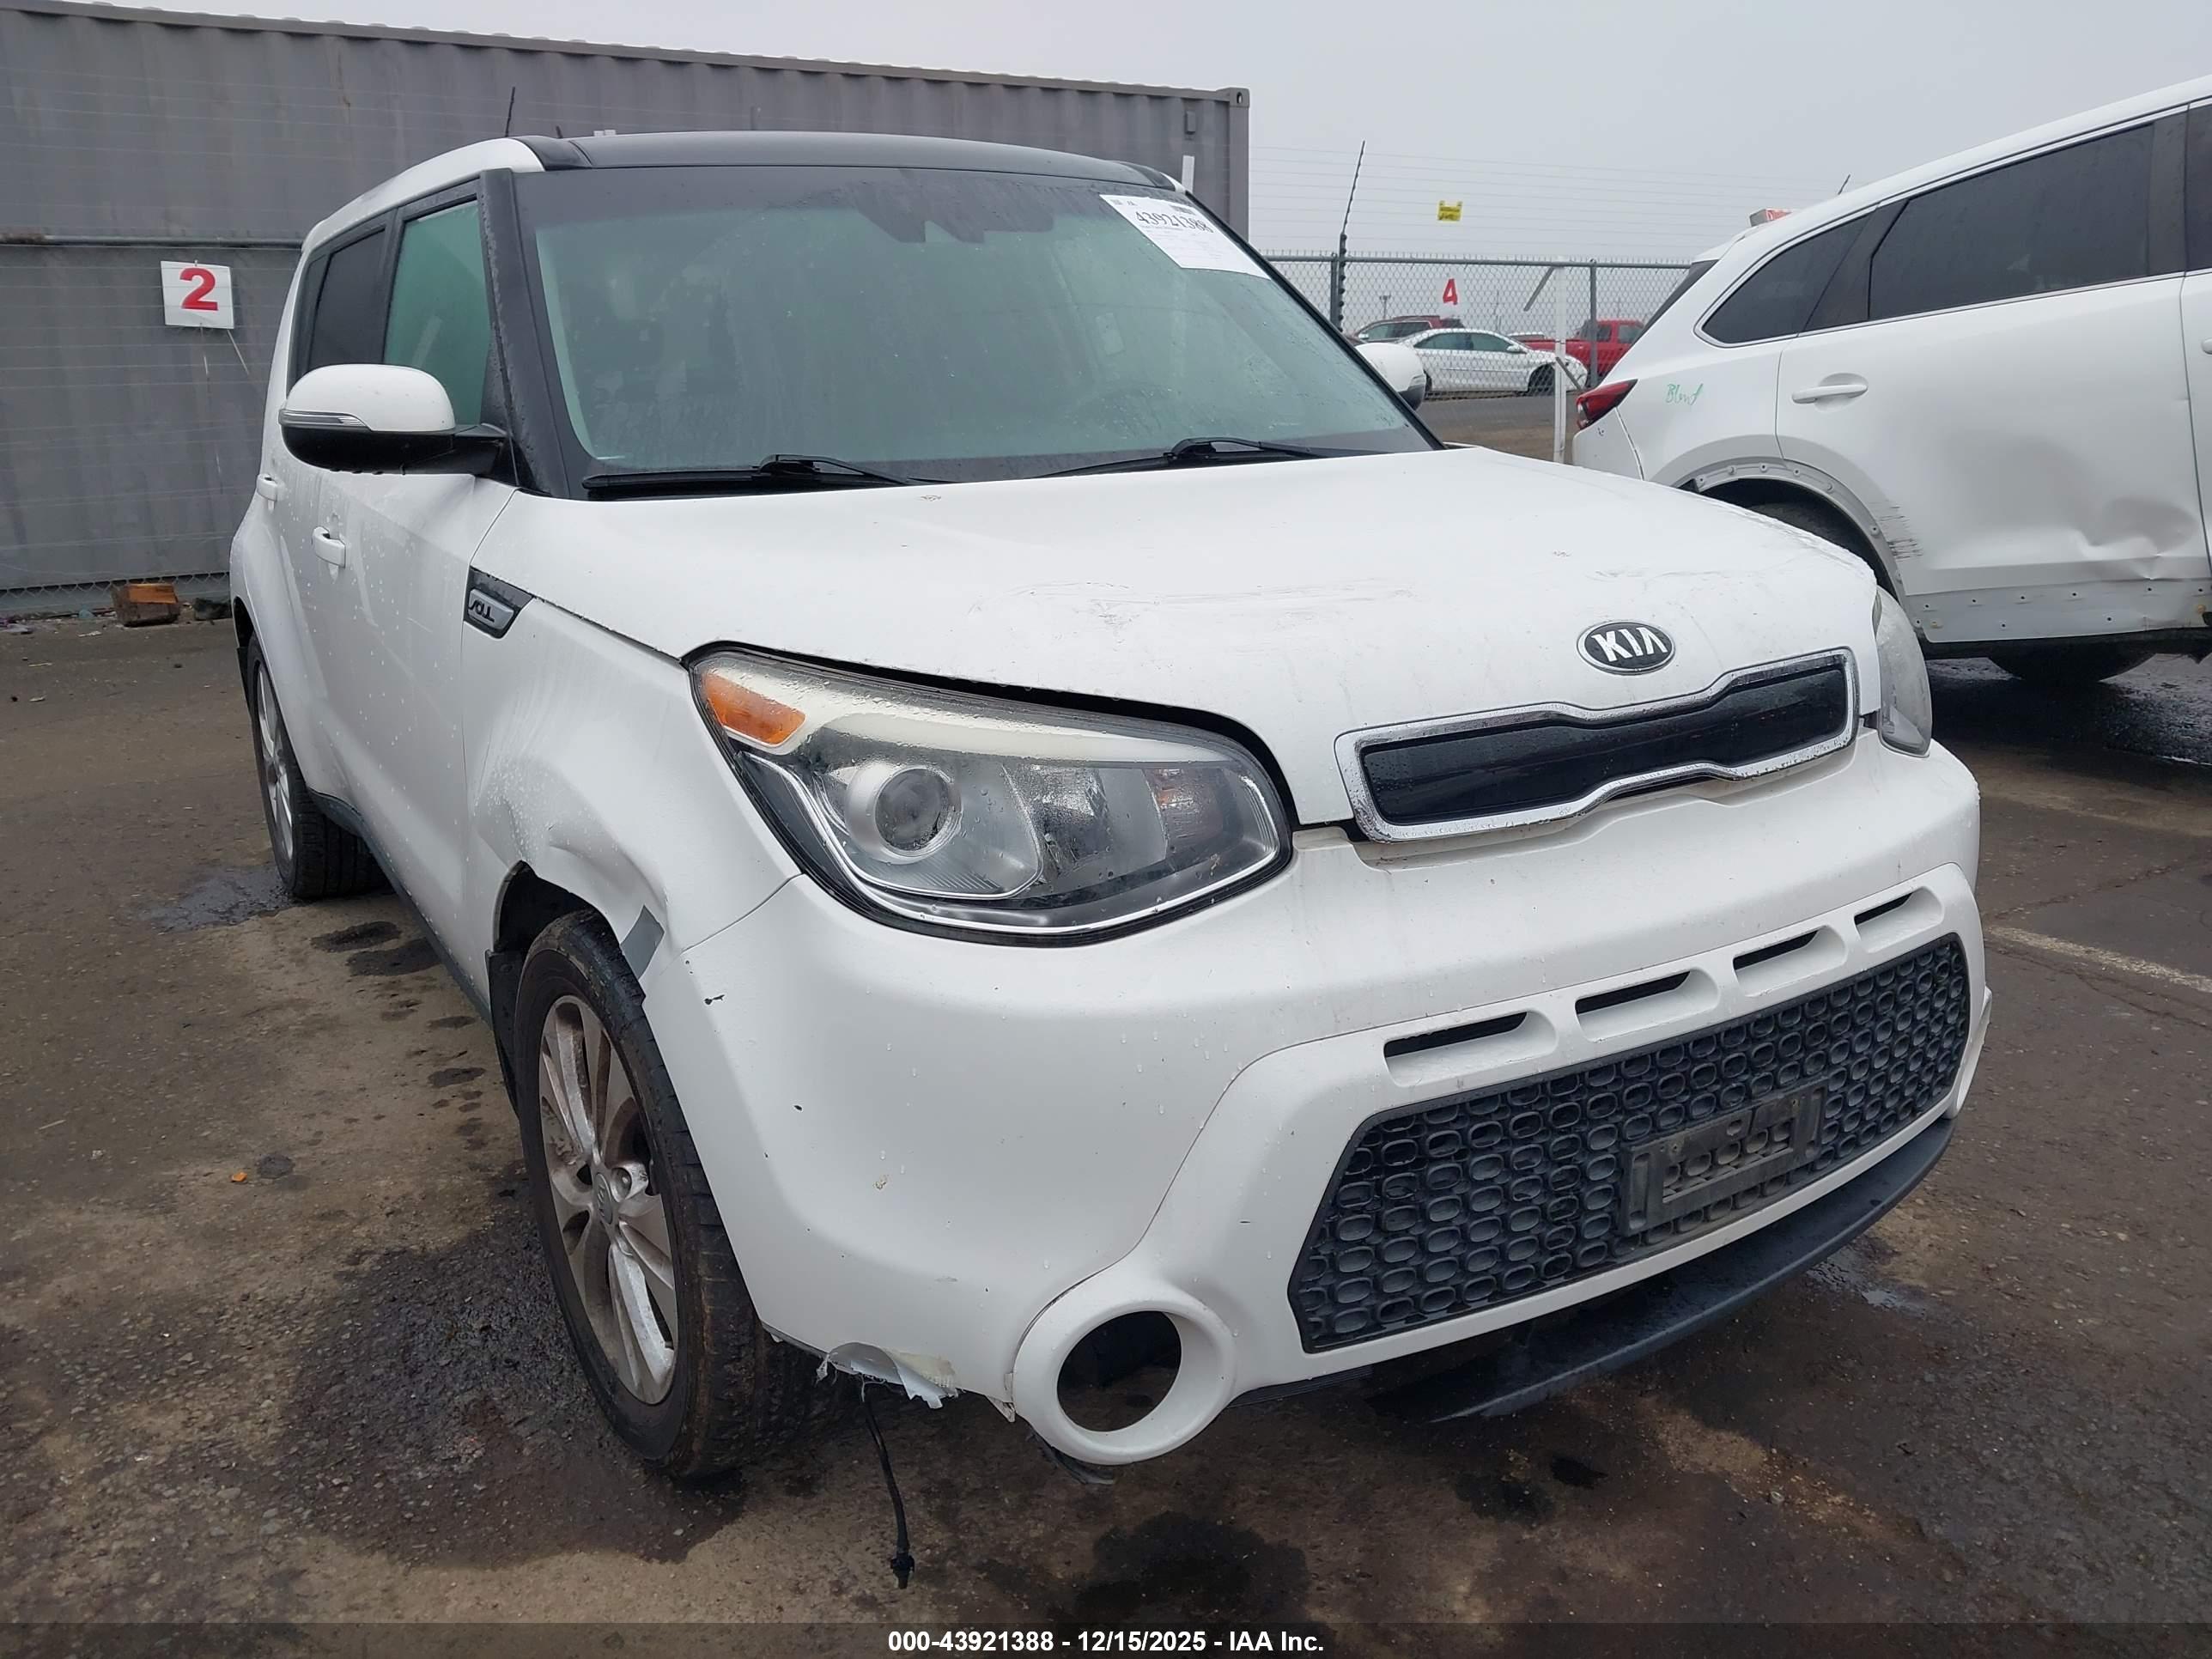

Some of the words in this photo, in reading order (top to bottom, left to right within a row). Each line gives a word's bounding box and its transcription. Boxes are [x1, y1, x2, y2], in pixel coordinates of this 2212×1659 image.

[179, 267, 219, 311] 2
[1442, 277, 1458, 306] 4
[1590, 627, 1668, 662] KIA
